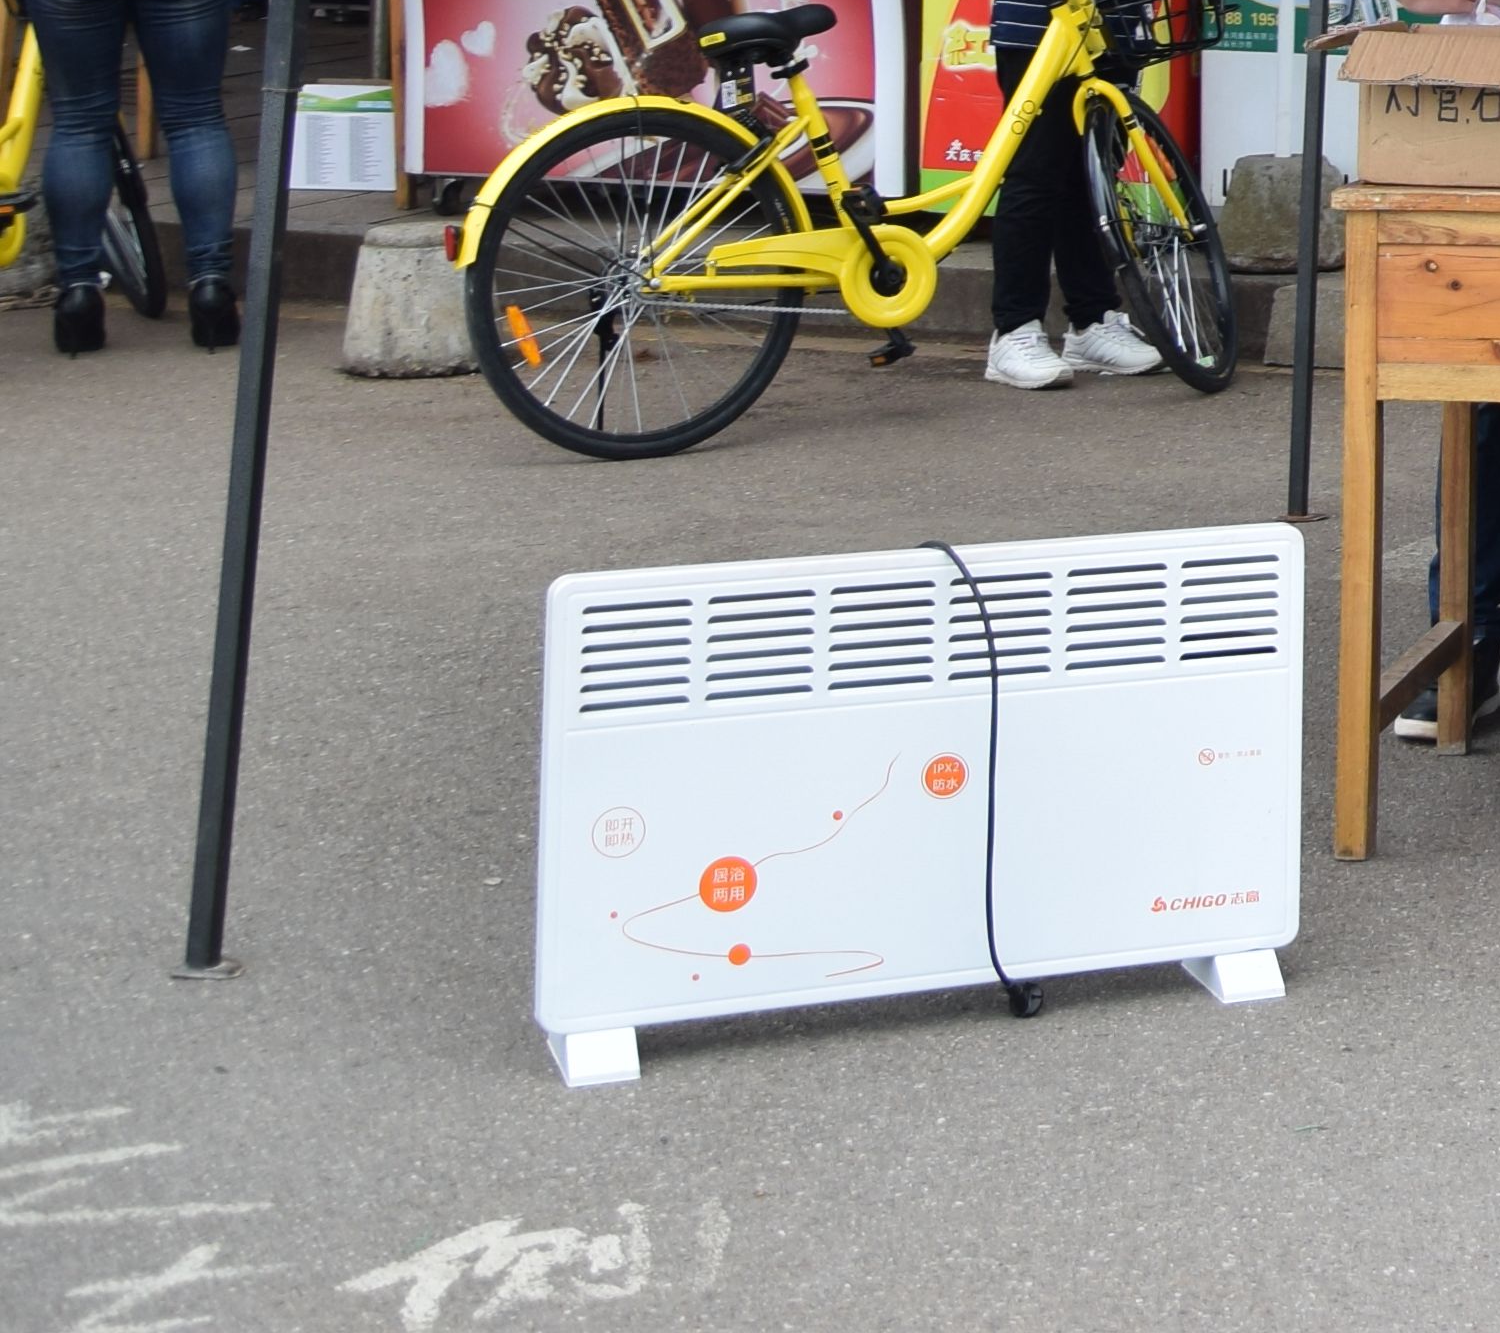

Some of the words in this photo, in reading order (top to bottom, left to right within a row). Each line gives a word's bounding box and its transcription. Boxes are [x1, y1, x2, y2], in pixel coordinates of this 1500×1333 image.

[1011, 99, 1037, 135] ofo
[933, 761, 960, 775] IPX2
[932, 777, 959, 791] 防水
[605, 817, 635, 832] 即开
[713, 867, 745, 883] 居浴
[713, 886, 745, 902] 两用
[1170, 894, 1227, 911] CHIGO
